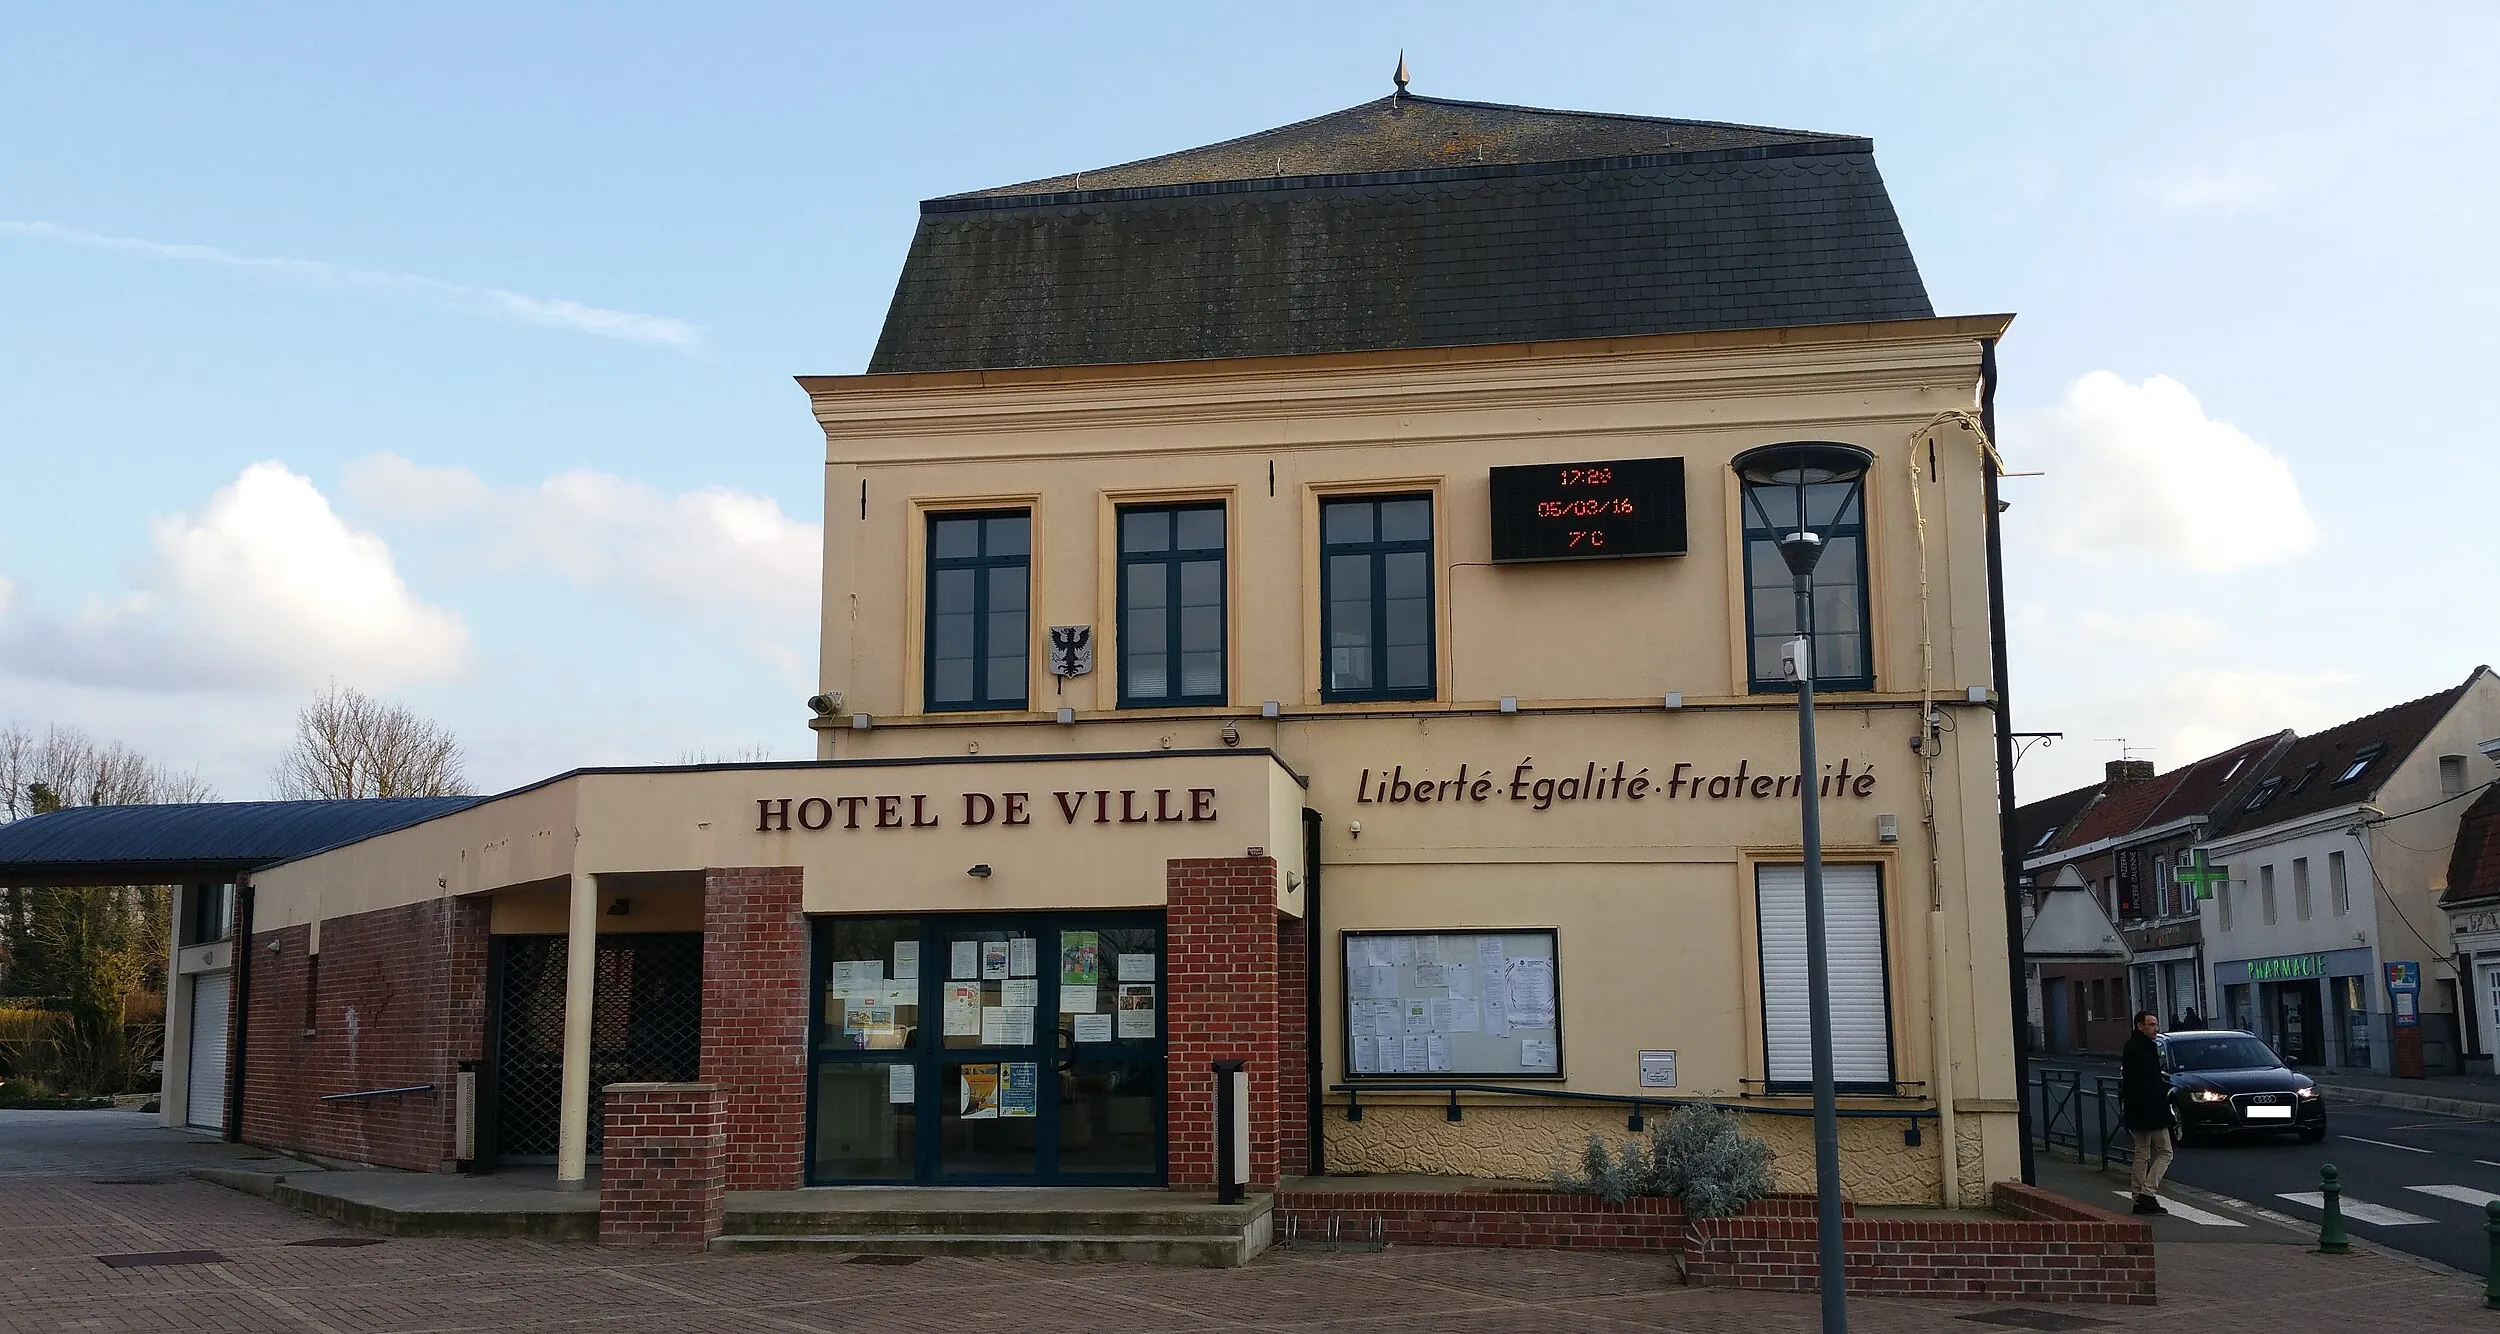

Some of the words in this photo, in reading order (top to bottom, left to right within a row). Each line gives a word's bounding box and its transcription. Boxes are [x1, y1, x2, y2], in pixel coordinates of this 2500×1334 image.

[1537, 498, 1633, 517] 05/03/16
[1357, 763, 1492, 806] Liberté
[1509, 756, 1650, 813] Égalité
[755, 795, 940, 836] HOTEL
[962, 792, 1031, 830] DE
[1053, 788, 1217, 826] VILLE
[2120, 851, 2128, 878] PIZZERIA
[2248, 955, 2327, 979] PHARMACIE
